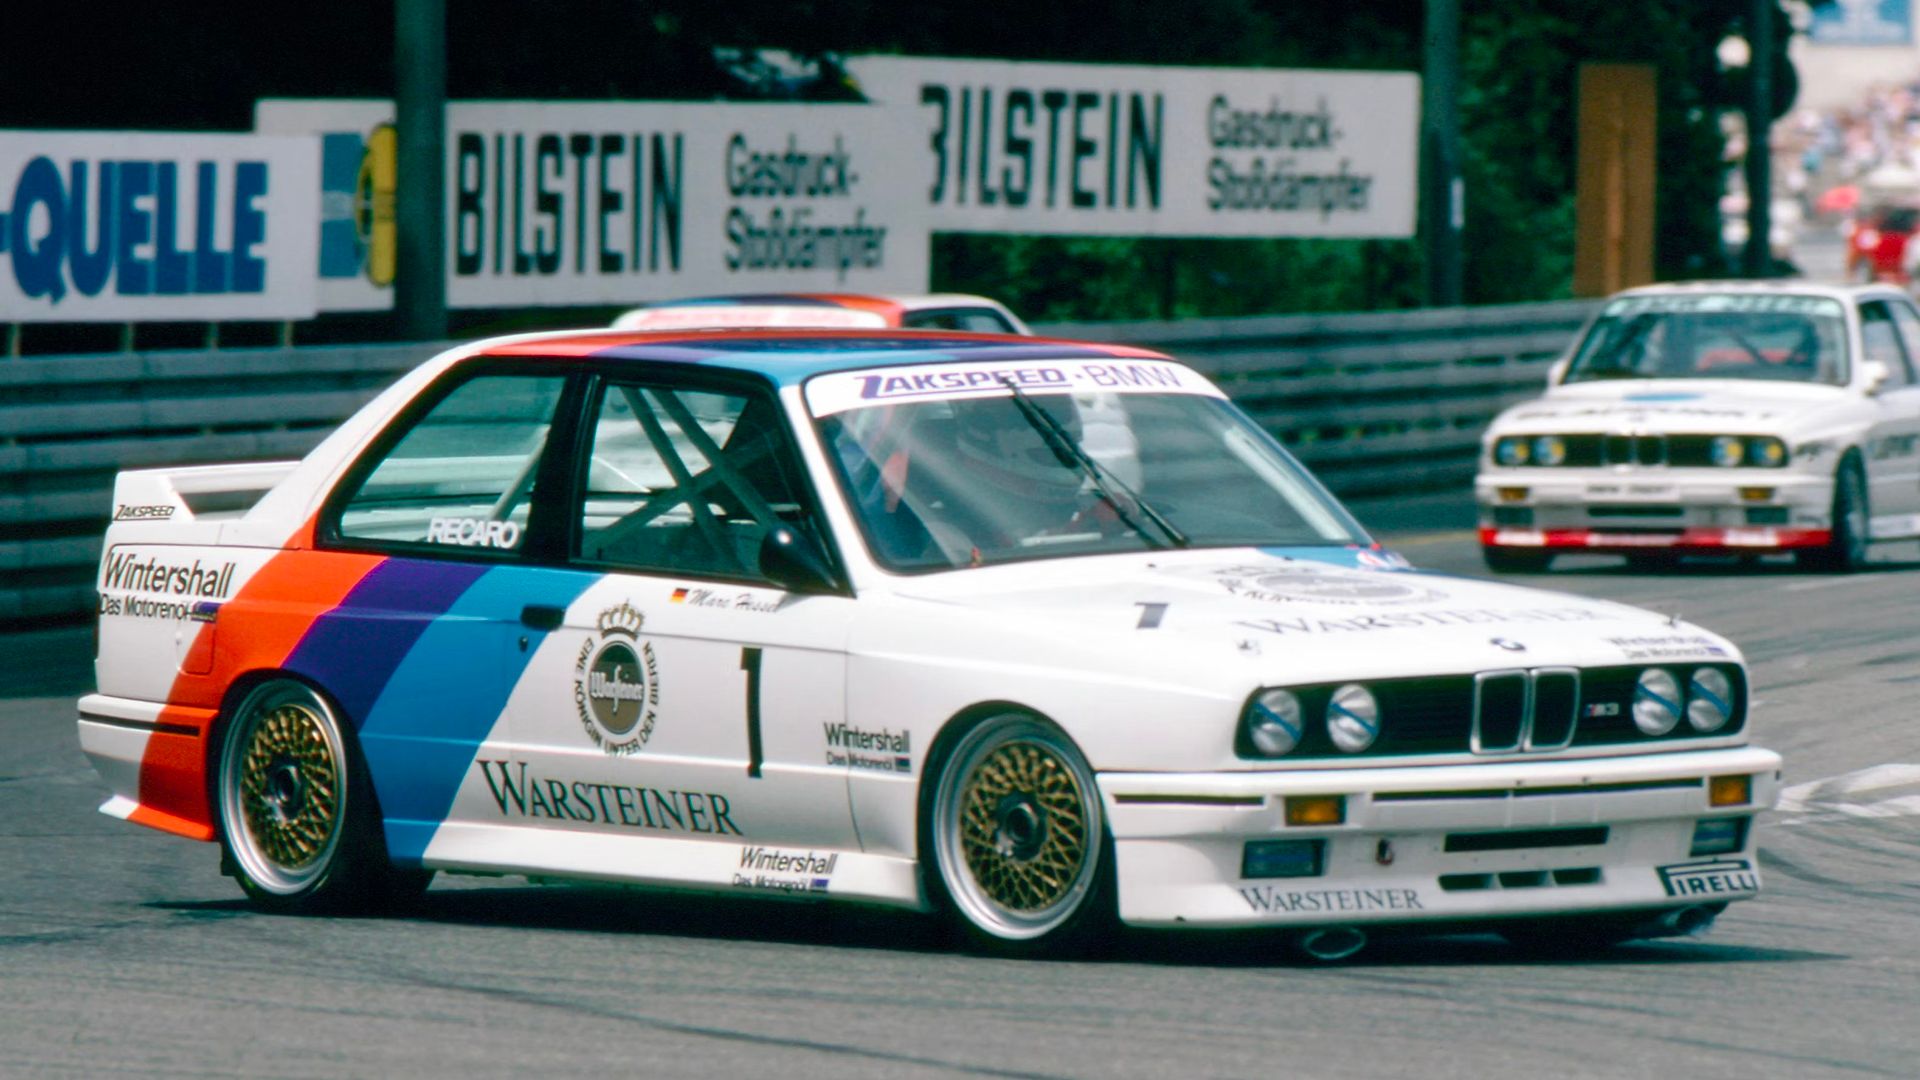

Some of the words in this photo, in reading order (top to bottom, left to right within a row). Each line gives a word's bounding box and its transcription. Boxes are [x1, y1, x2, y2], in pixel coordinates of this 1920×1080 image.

[1207, 93, 1343, 151] Gasdruck-
[920, 83, 1165, 210] BILSTEIN
[725, 131, 860, 198] Gasdruck-
[455, 131, 684, 275] BILSTEIN
[854, 367, 1069, 399] ZAKSPEED
[1082, 365, 1183, 388] BMW
[114, 504, 176, 521] ZAKSPEED
[427, 517, 519, 549] RECARO
[104, 552, 236, 598] Wintershall
[100, 594, 121, 616] Das
[1134, 602, 1169, 629] 1
[740, 646, 764, 778] 1
[1594, 703, 1619, 716] M3
[823, 722, 910, 753] Wintershall
[477, 760, 743, 836] WARSTEINER
[740, 846, 838, 874] Wintershall
[1655, 860, 1758, 897] PIRELLI
[1239, 886, 1425, 915] WARSTEINER
